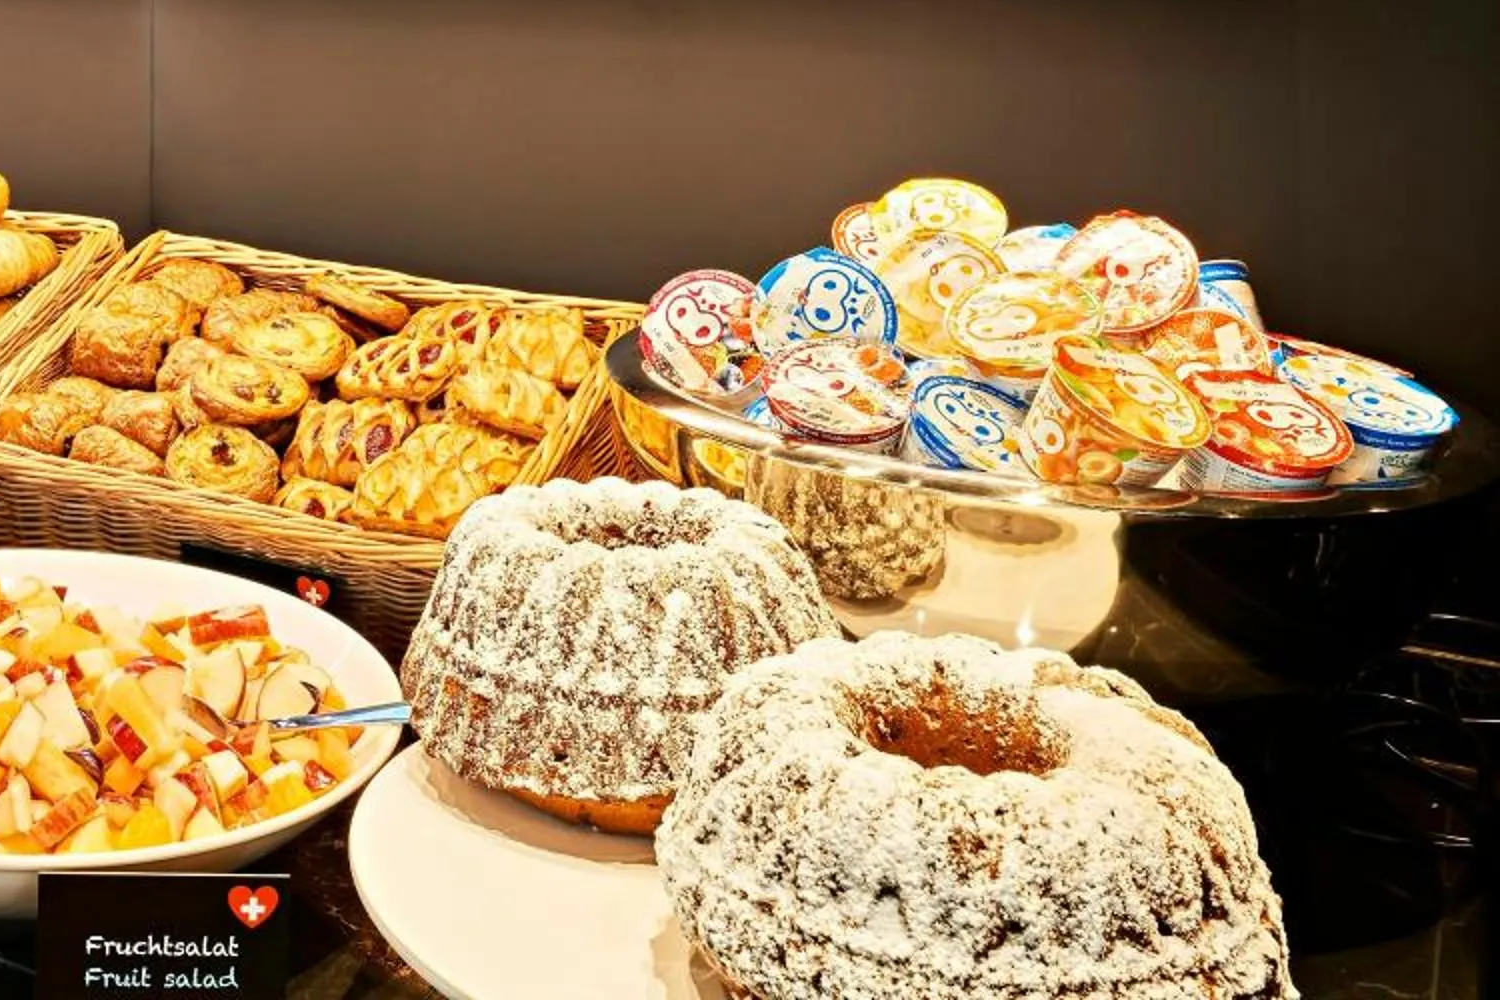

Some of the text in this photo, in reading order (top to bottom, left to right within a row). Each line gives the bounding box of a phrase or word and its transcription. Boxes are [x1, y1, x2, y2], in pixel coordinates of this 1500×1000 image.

[85, 935, 240, 957] Fruchtsalat
[84, 966, 240, 989] Fruit salad
